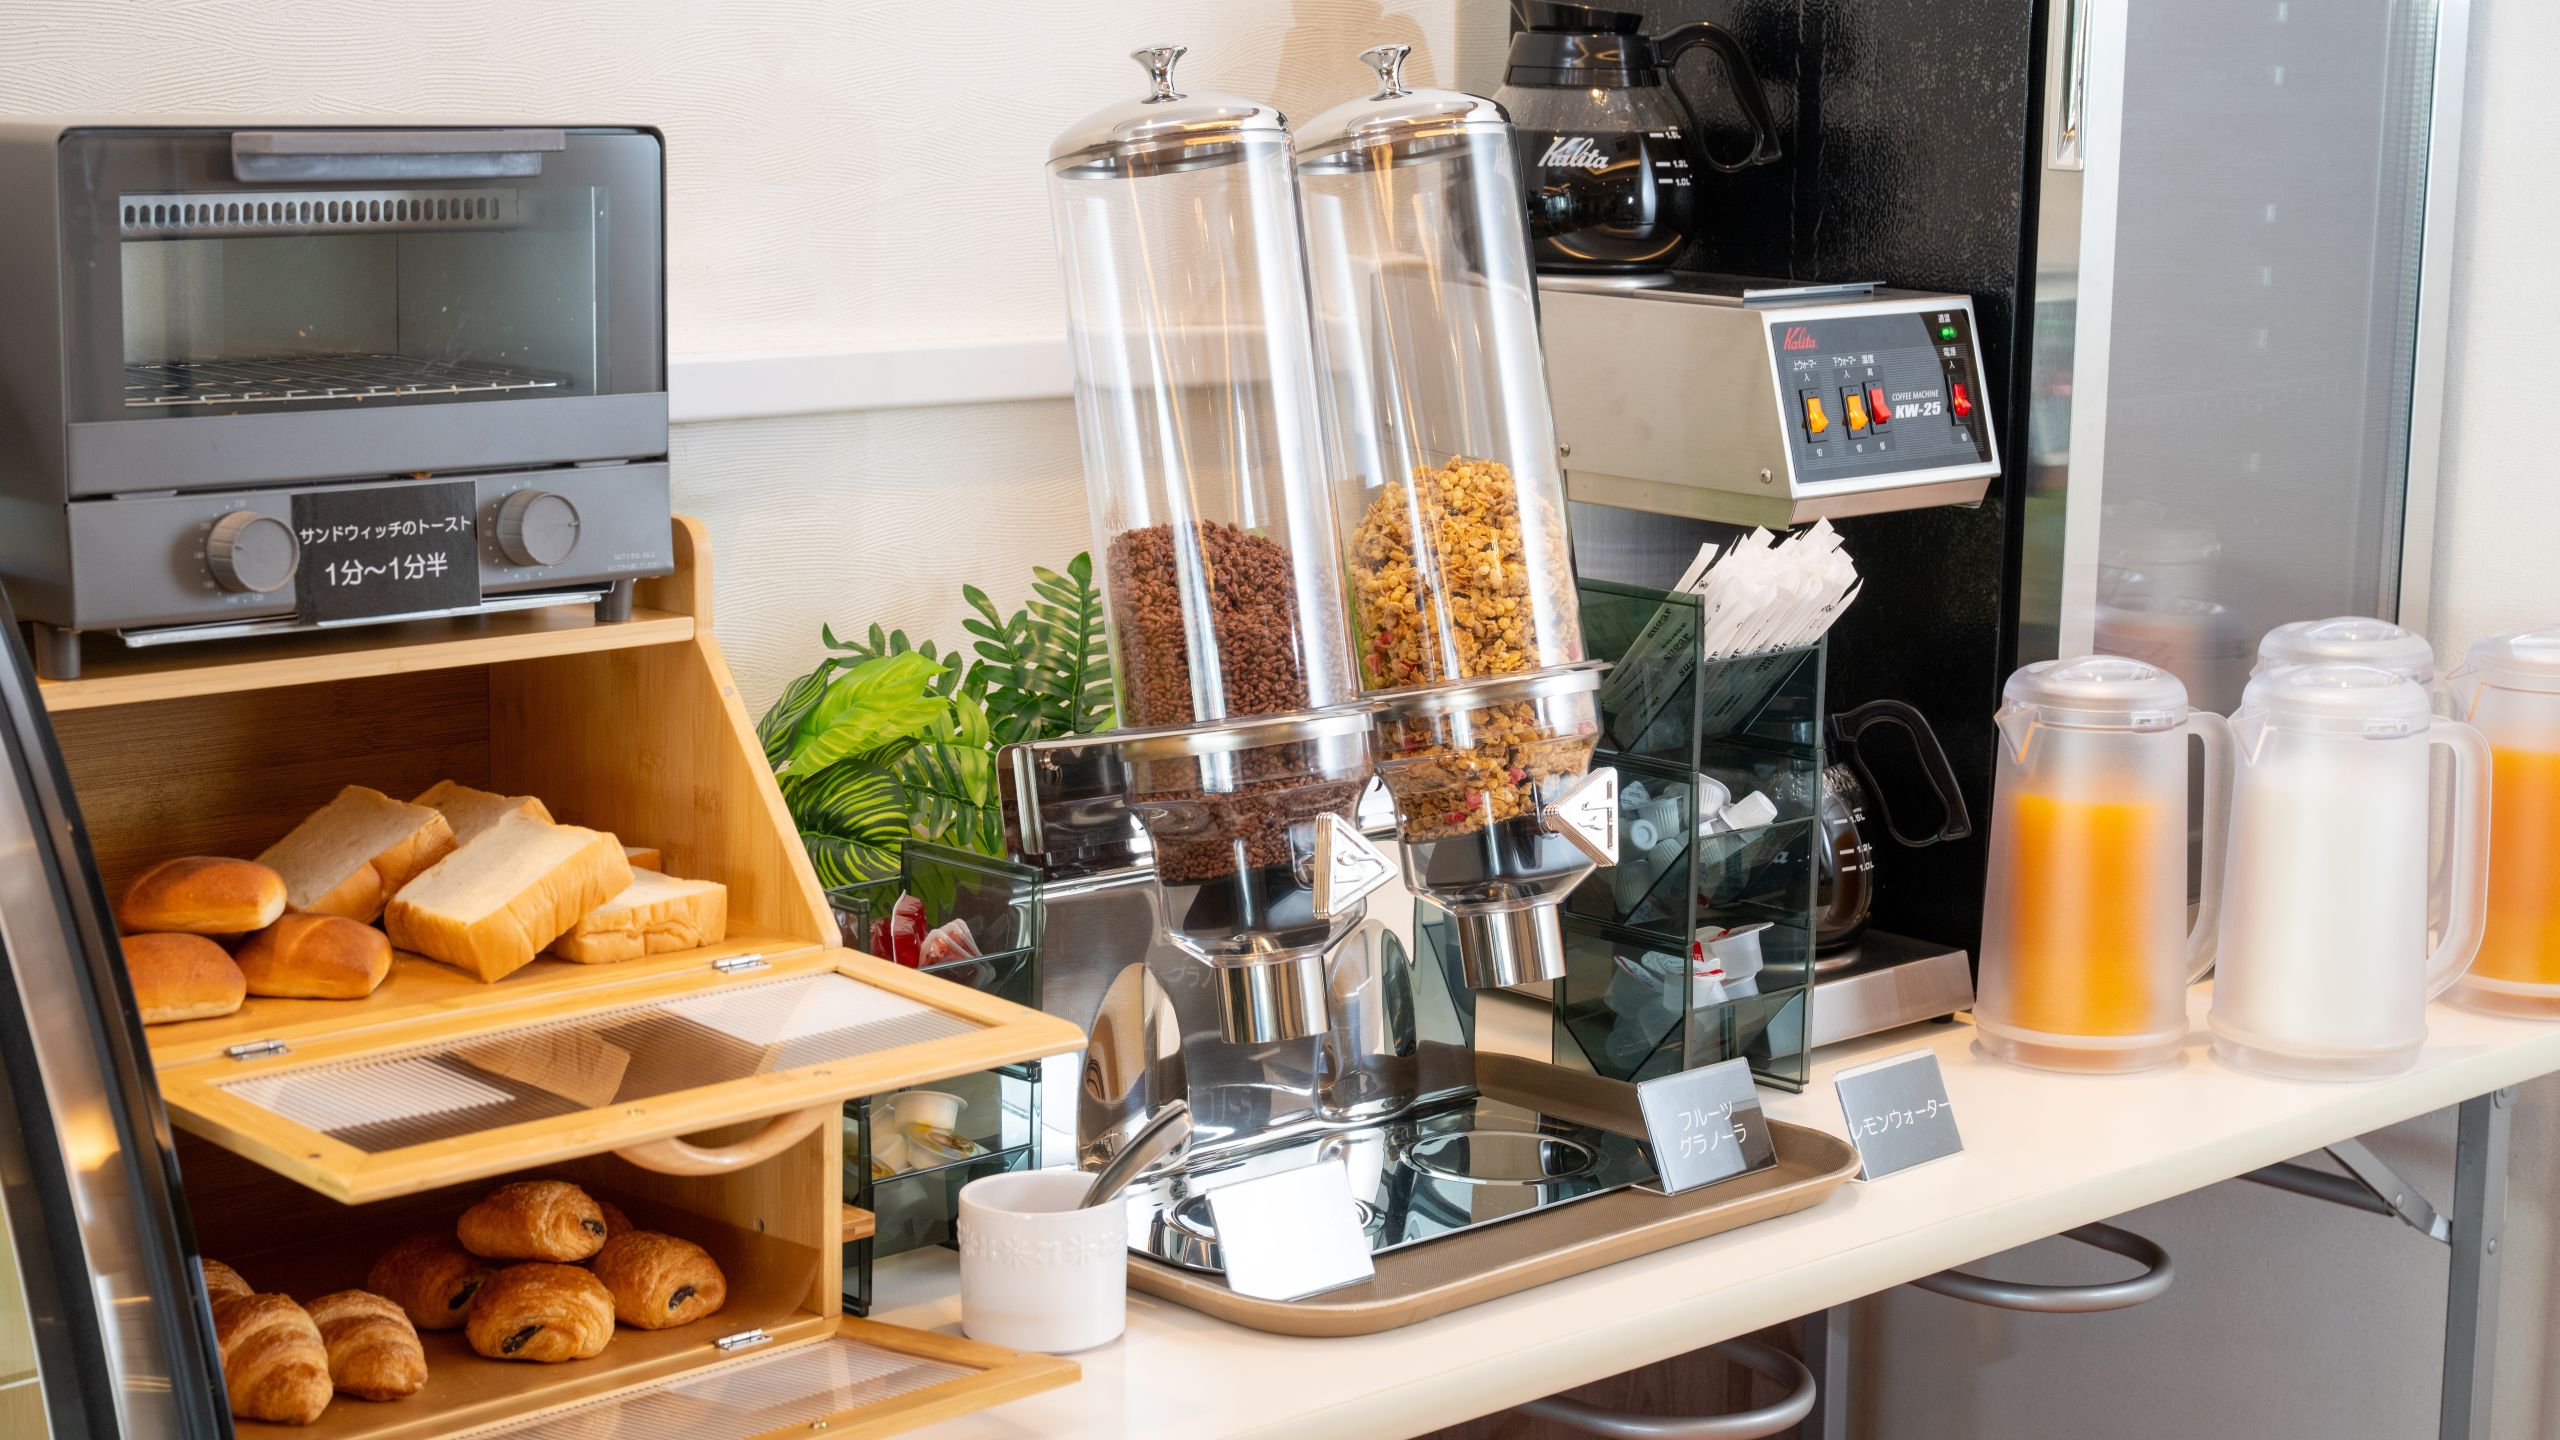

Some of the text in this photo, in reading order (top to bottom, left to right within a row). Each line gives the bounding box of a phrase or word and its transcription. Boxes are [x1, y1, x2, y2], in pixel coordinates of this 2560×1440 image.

[1538, 136, 1609, 169] Kalita
[1783, 326, 1818, 351] Kalita
[1892, 389, 1939, 401] COFFEE MACHINE
[1895, 401, 1941, 419] KW-25
[300, 515, 471, 545] サンドウィッチのトースト
[1849, 813, 1866, 824] 1.5L
[1857, 842, 1873, 853] 1.2L
[1859, 861, 1875, 872] 1.0L
[1677, 1100, 1733, 1132] フルーツ
[1679, 1122, 1747, 1159] グラノーラ
